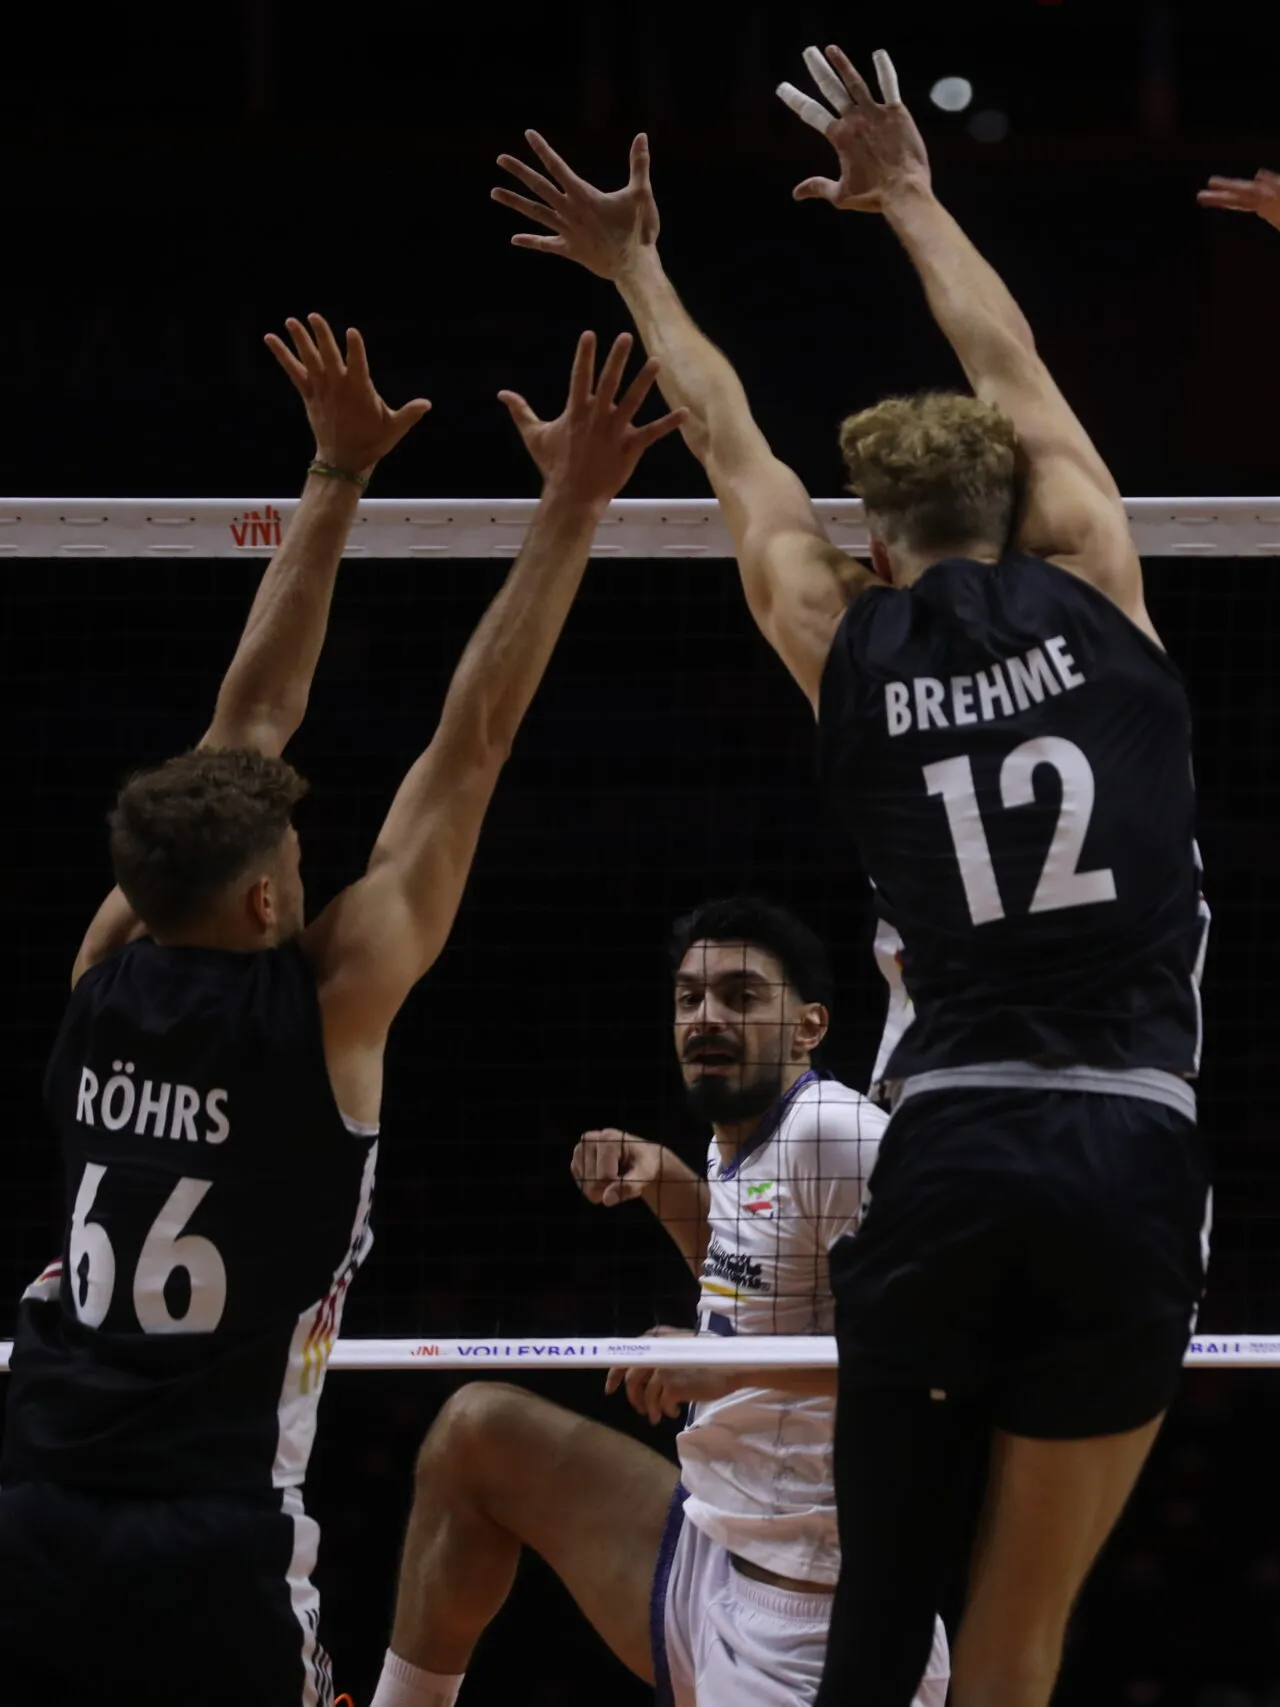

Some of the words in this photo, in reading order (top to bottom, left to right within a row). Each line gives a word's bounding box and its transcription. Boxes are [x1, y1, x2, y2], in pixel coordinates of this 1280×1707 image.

[885, 634, 1086, 737] BREHME
[922, 735, 1117, 926] 12
[76, 1060, 230, 1144] RÖHRS
[69, 1161, 228, 1335] 66
[457, 1345, 598, 1357] VOLLEYBALL
